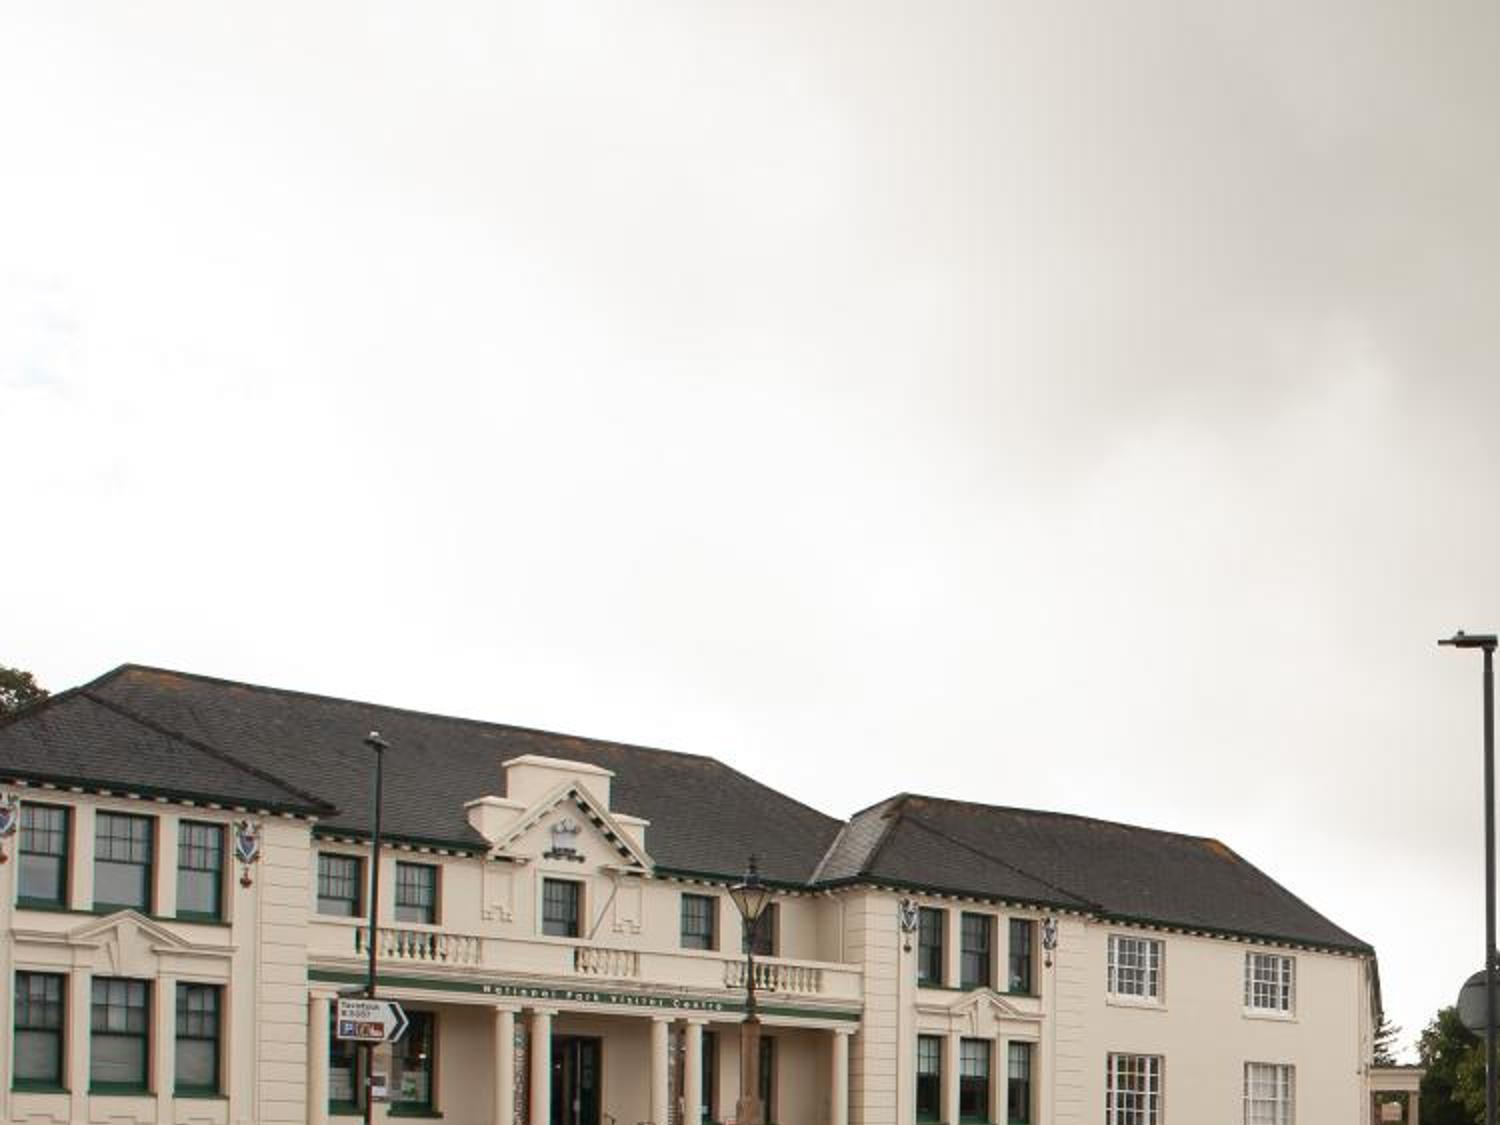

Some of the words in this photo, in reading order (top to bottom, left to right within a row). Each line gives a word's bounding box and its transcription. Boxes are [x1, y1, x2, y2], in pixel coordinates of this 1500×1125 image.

[483, 984, 557, 998] National
[566, 990, 599, 1002] Park
[610, 994, 663, 1007] Visitor
[672, 998, 722, 1011] Centre
